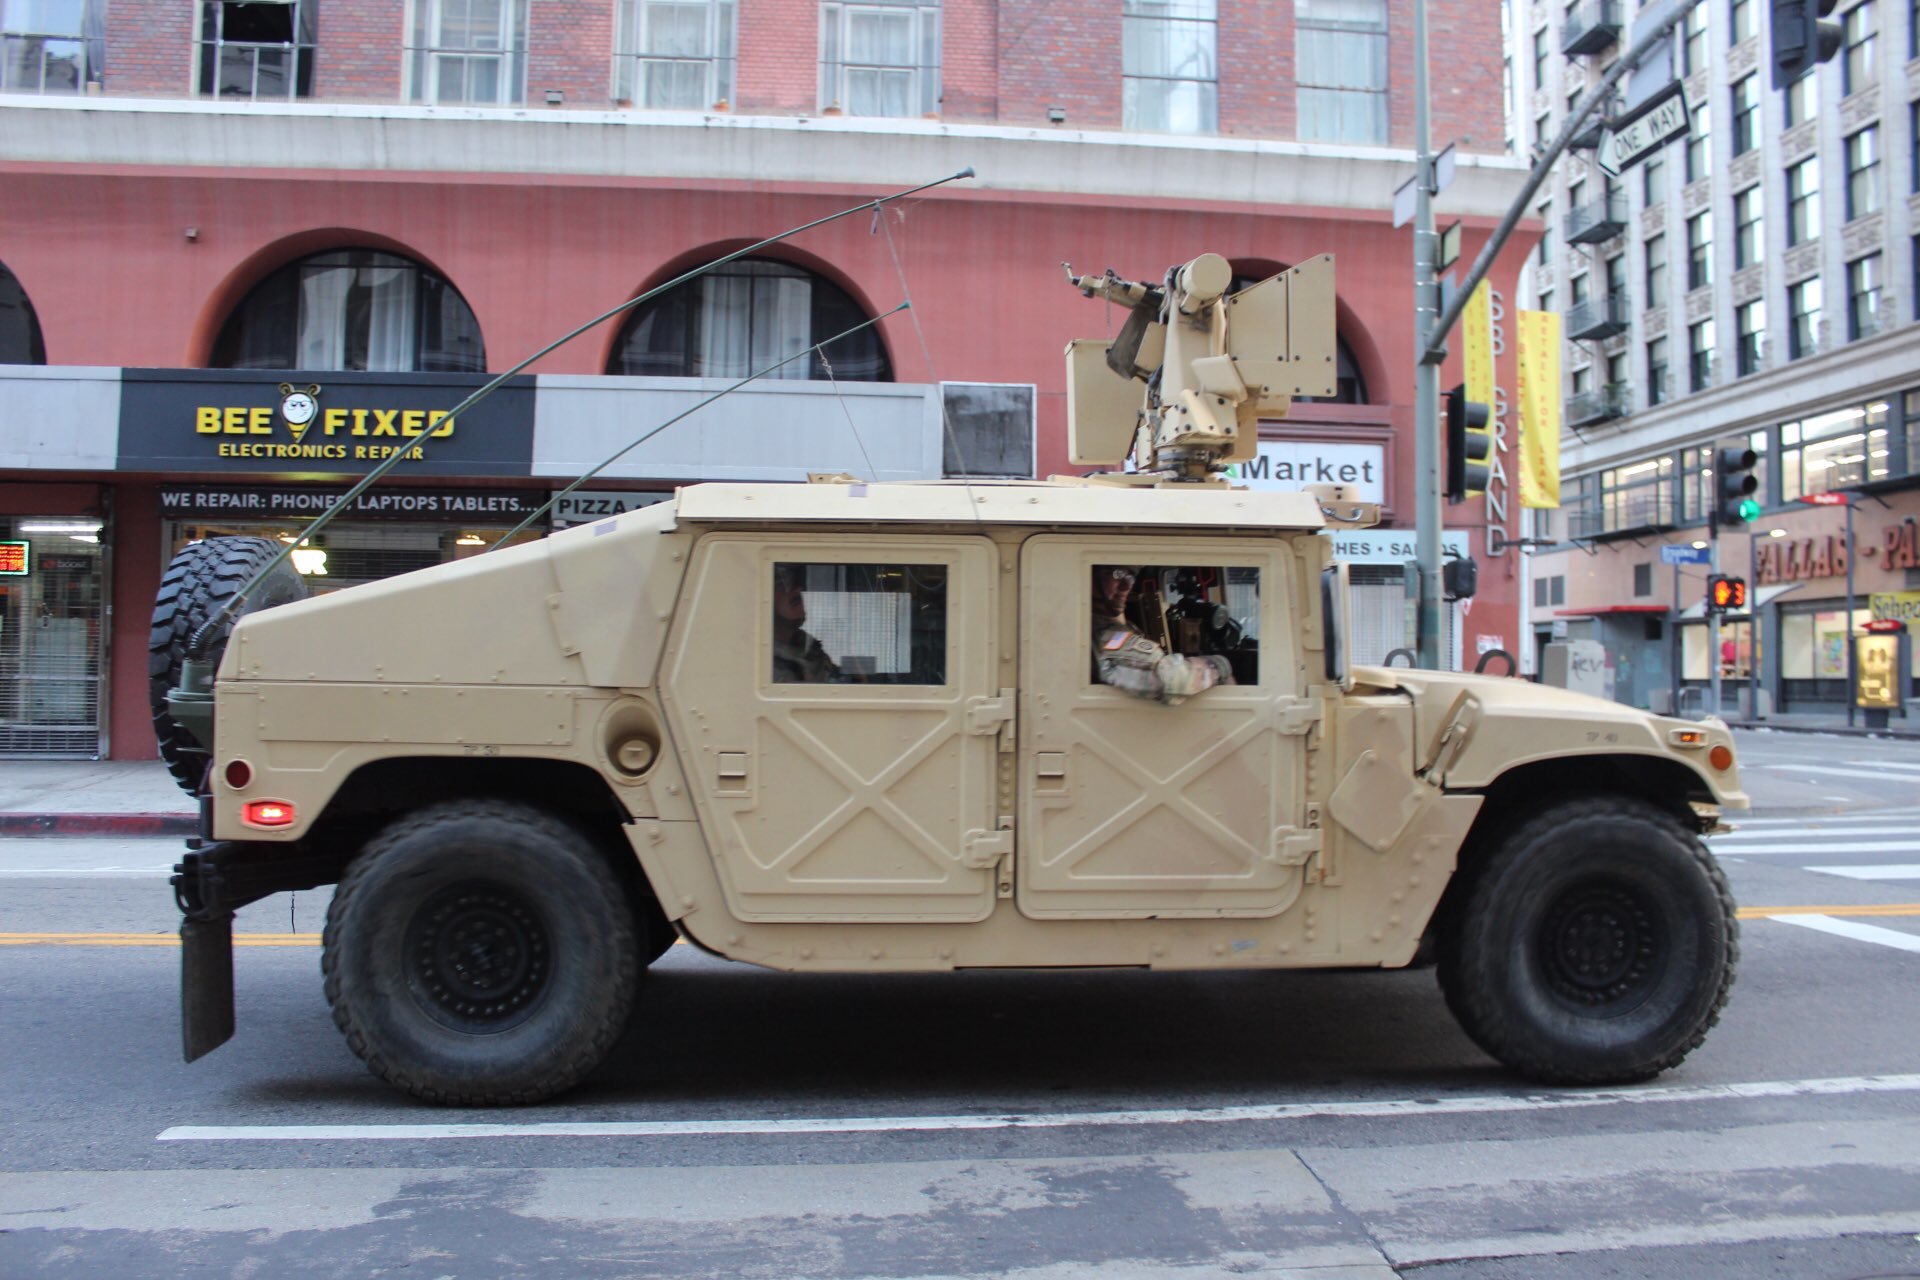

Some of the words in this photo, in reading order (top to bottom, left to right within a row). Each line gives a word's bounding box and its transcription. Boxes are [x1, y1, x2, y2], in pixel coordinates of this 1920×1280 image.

[1614, 126, 1641, 160] ONE
[1647, 99, 1679, 139] WAY
[196, 406, 274, 435] BEE
[323, 408, 456, 438] FIXED
[218, 443, 347, 459] ELECTRONICS
[355, 445, 424, 460] REPAIR
[1241, 455, 1374, 484] Market
[1486, 386, 1508, 557] GRAND
[161, 492, 191, 508] WE
[195, 493, 266, 508] REPAIR:
[357, 495, 438, 511] LAPTOPS
[442, 496, 538, 512] TABLETS...
[558, 498, 627, 515] PIZZA
[1331, 542, 1371, 556] HES
[1390, 543, 1459, 557] SAS
[1880, 522, 1920, 572] PA
